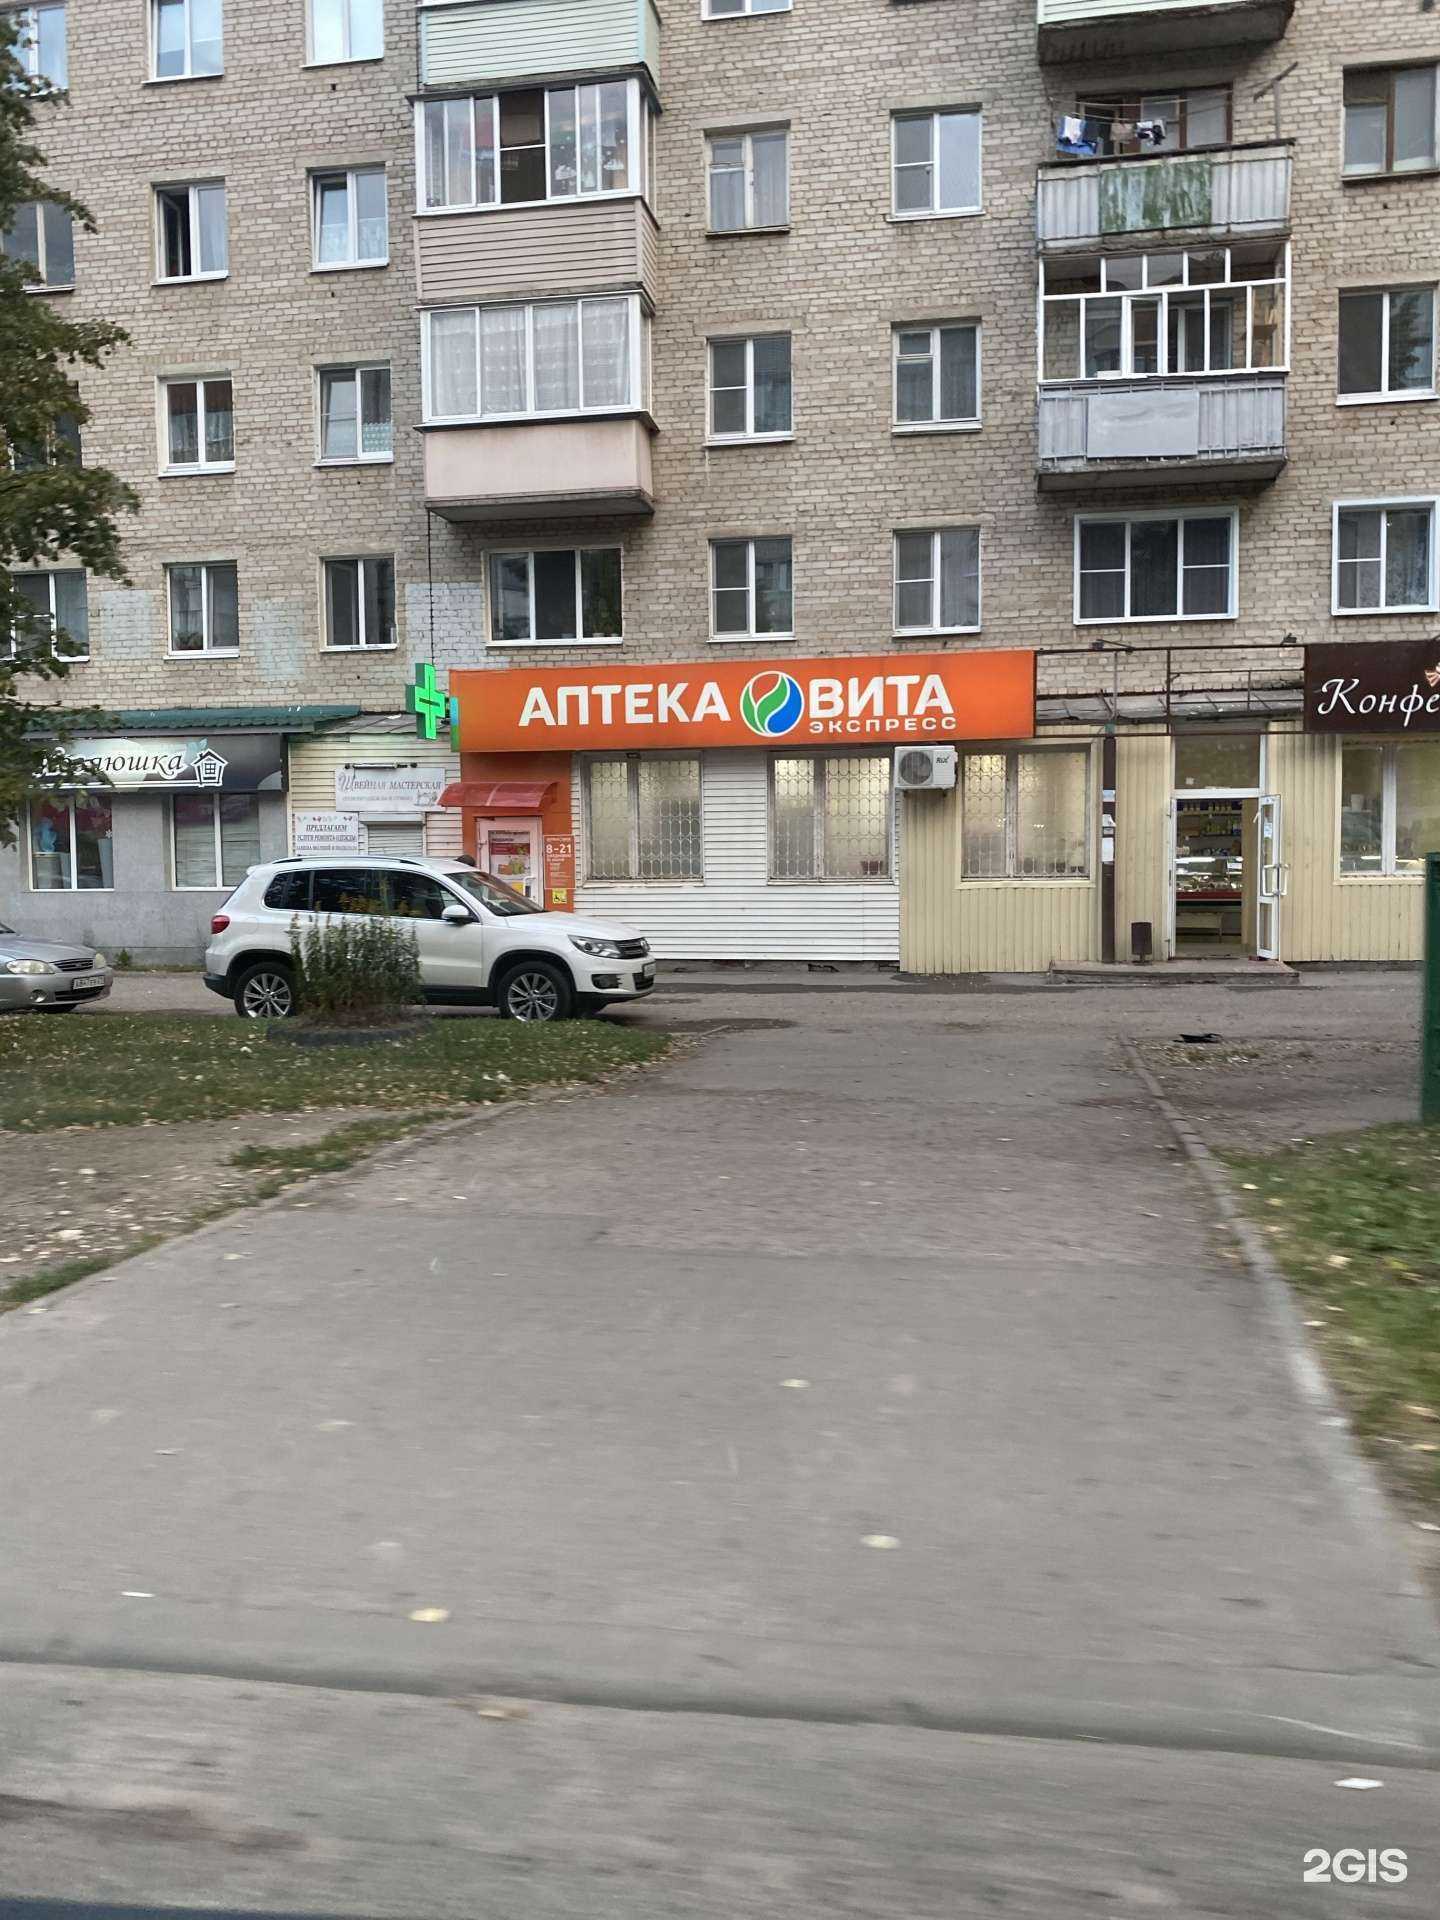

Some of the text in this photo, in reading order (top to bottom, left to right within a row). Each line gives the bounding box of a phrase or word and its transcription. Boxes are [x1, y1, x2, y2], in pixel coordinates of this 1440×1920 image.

[518, 681, 732, 727] АПТЕКА
[808, 674, 954, 719] ВИТА
[1317, 678, 1440, 727] Конфе
[809, 716, 957, 734] ЭКСПРЕСС
[388, 780, 442, 791] МАСТЕРСКАЯ
[546, 843, 572, 854] 8-21
